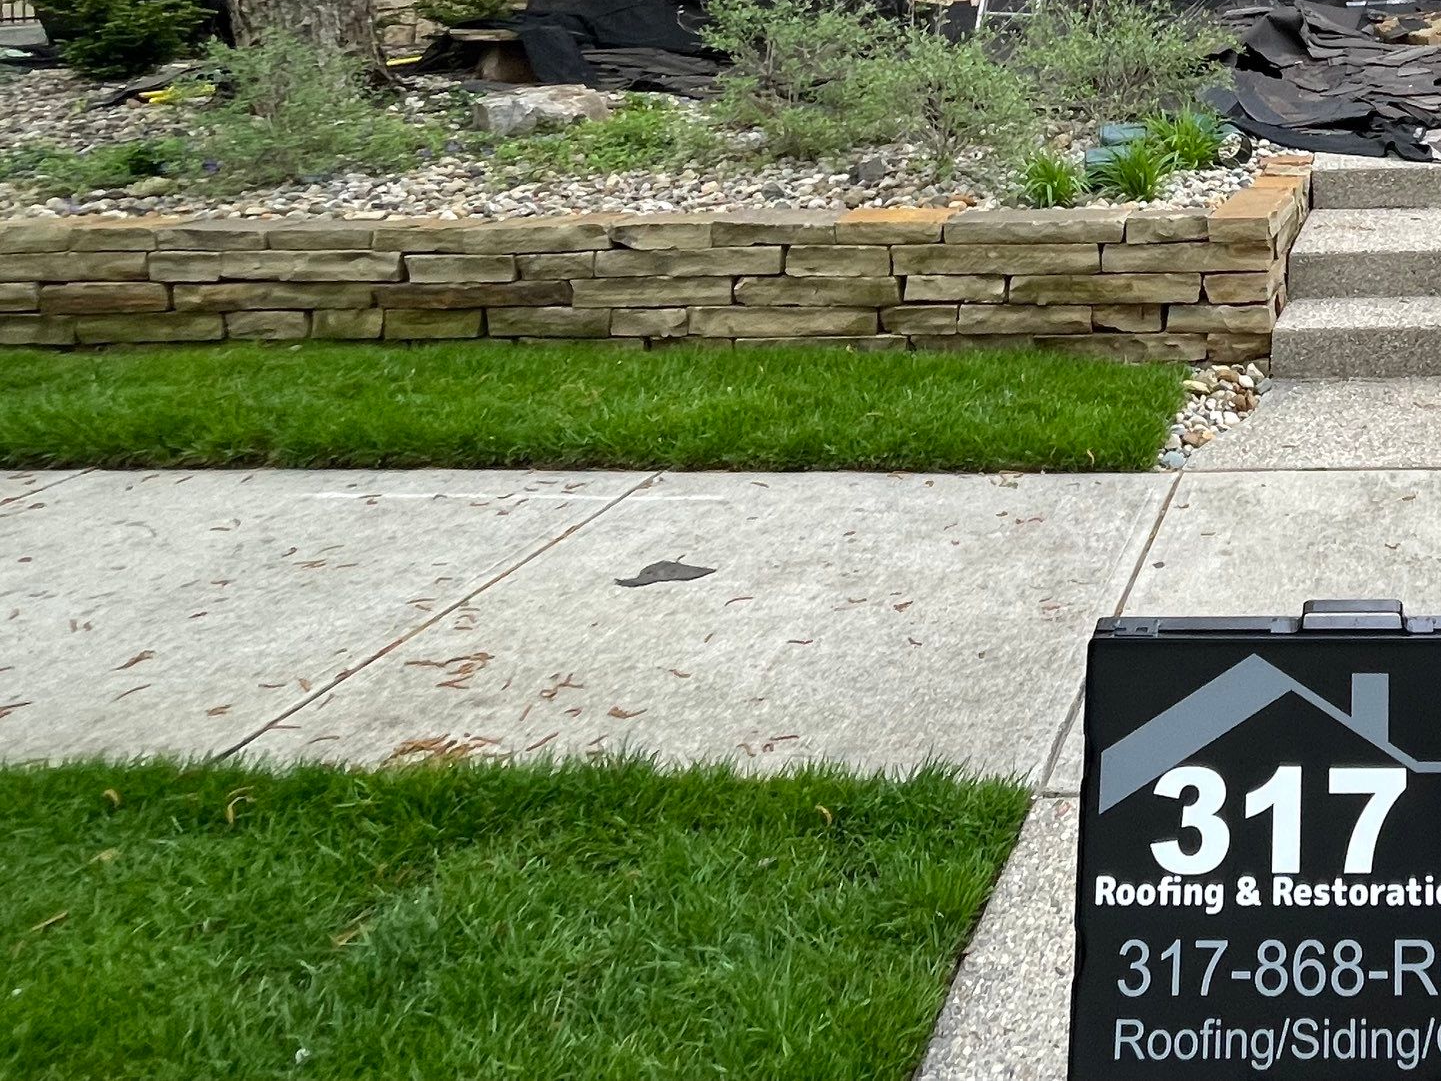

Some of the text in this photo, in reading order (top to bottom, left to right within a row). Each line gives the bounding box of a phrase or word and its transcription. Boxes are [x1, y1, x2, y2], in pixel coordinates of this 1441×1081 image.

[1150, 764, 1408, 875] 317
[1094, 874, 1225, 915] Roofing
[1235, 876, 1261, 907] &
